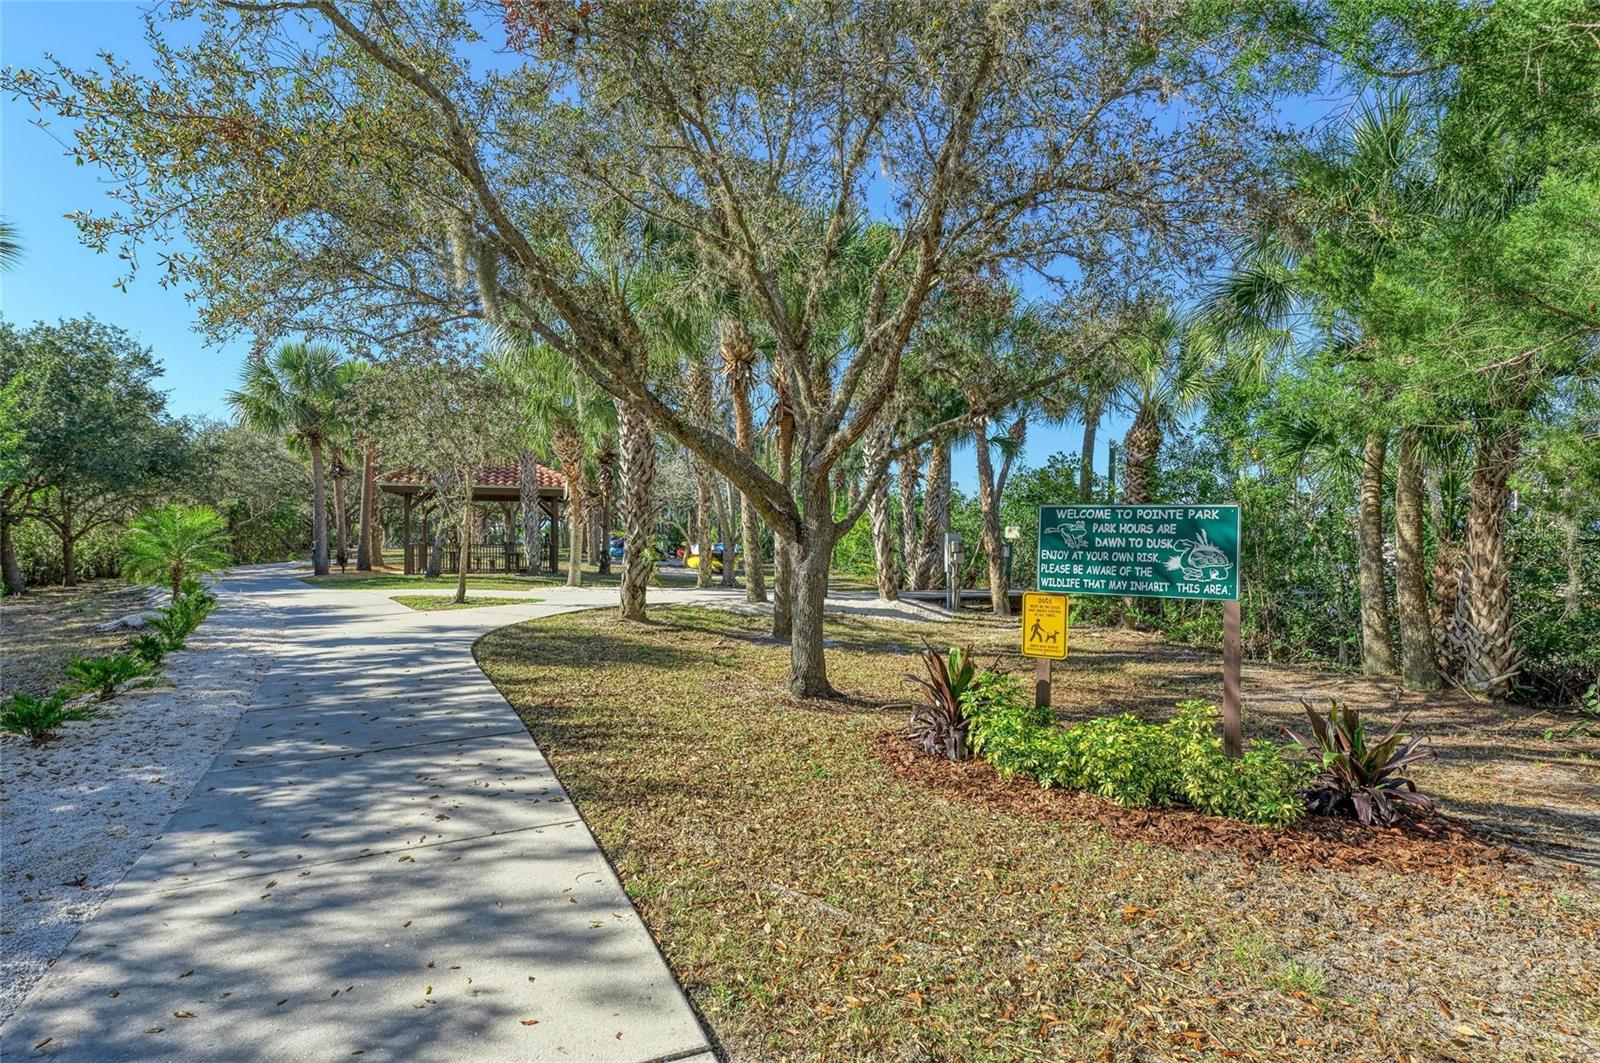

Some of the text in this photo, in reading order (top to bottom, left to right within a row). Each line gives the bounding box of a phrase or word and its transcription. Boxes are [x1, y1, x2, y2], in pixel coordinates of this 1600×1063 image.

[1056, 509, 1220, 520] WELCOME TO POINTE PARK
[1092, 524, 1176, 534] PARK HOURS ARE
[1095, 538, 1173, 548] DAWN TO DUSK
[1041, 550, 1161, 563] ENJOY AT YOUR OWN RISK.
[1040, 564, 1152, 577] PLEASE BE AWARE OF THE
[1040, 578, 1232, 596] WILDLIFE THAT MAY INHABIT THIS AREA.
